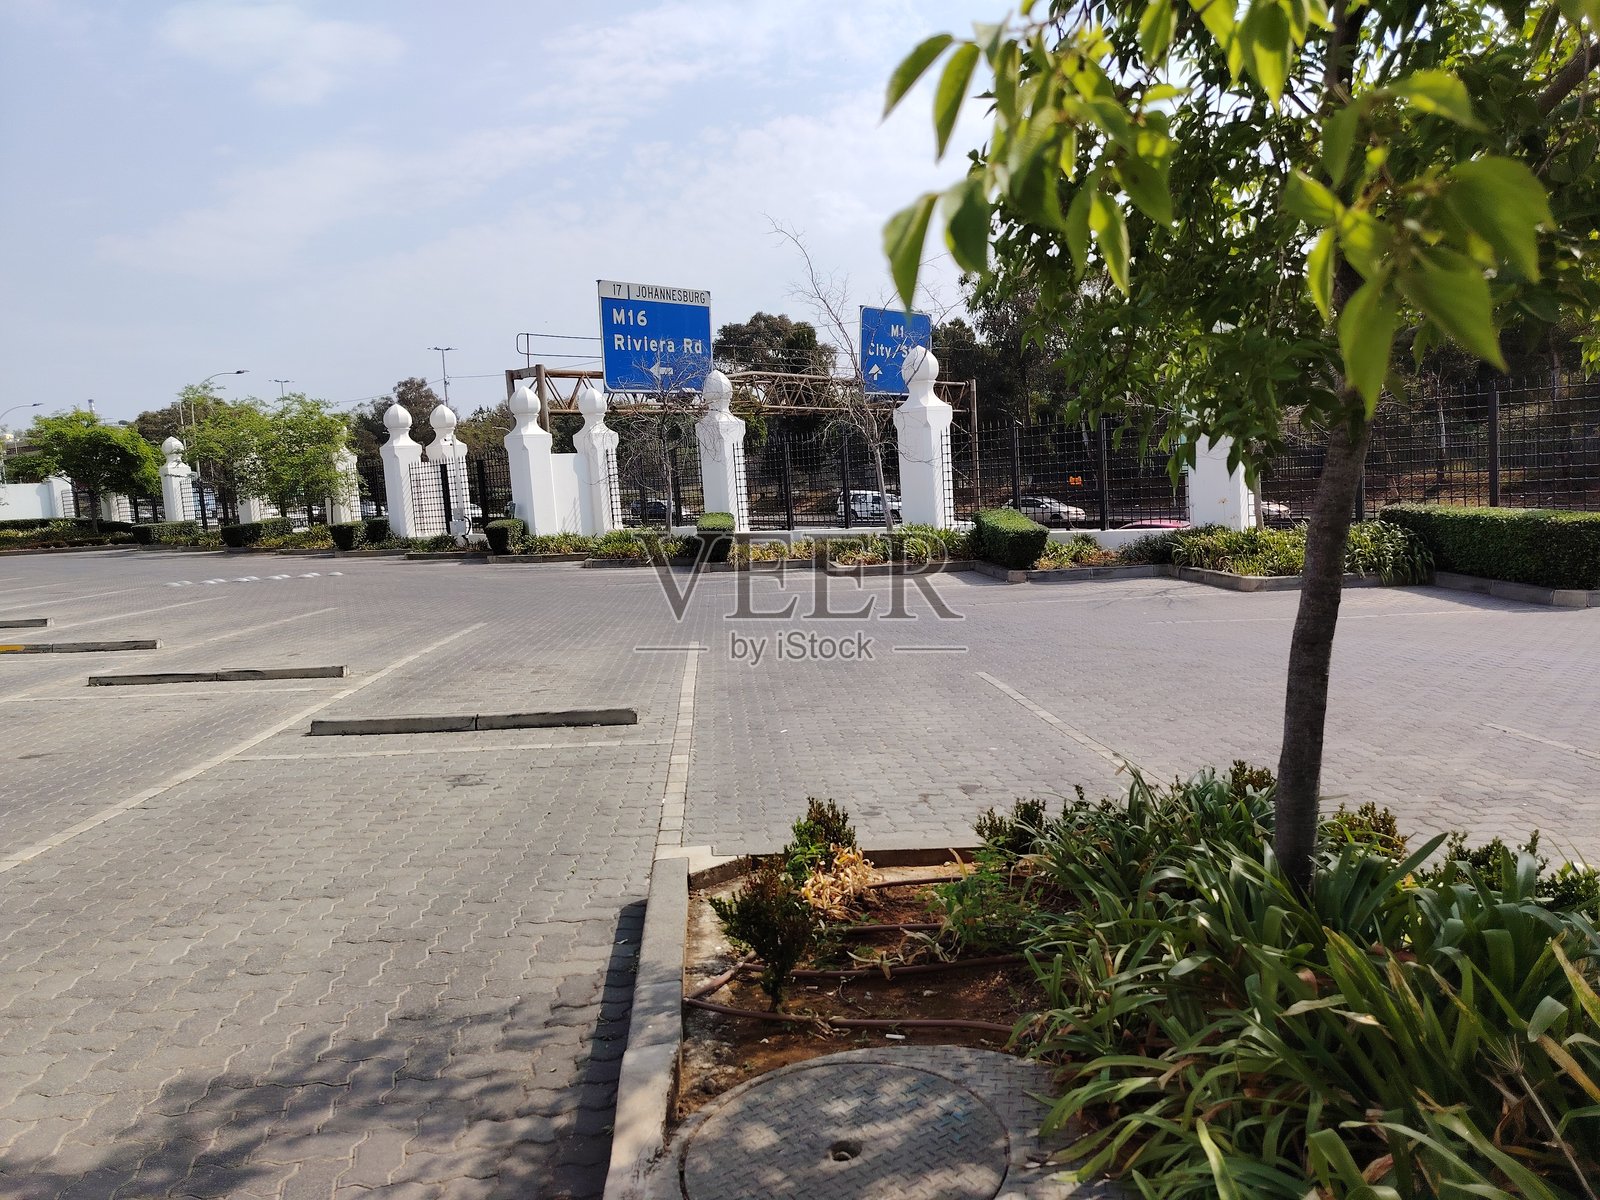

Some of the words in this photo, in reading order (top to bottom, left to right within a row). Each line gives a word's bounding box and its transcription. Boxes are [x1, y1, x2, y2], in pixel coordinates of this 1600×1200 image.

[613, 284, 622, 296] 17
[636, 286, 706, 304] JOHANNESBURG
[612, 308, 648, 326] M16
[614, 334, 675, 352] Riviera
[683, 338, 703, 354] Rd
